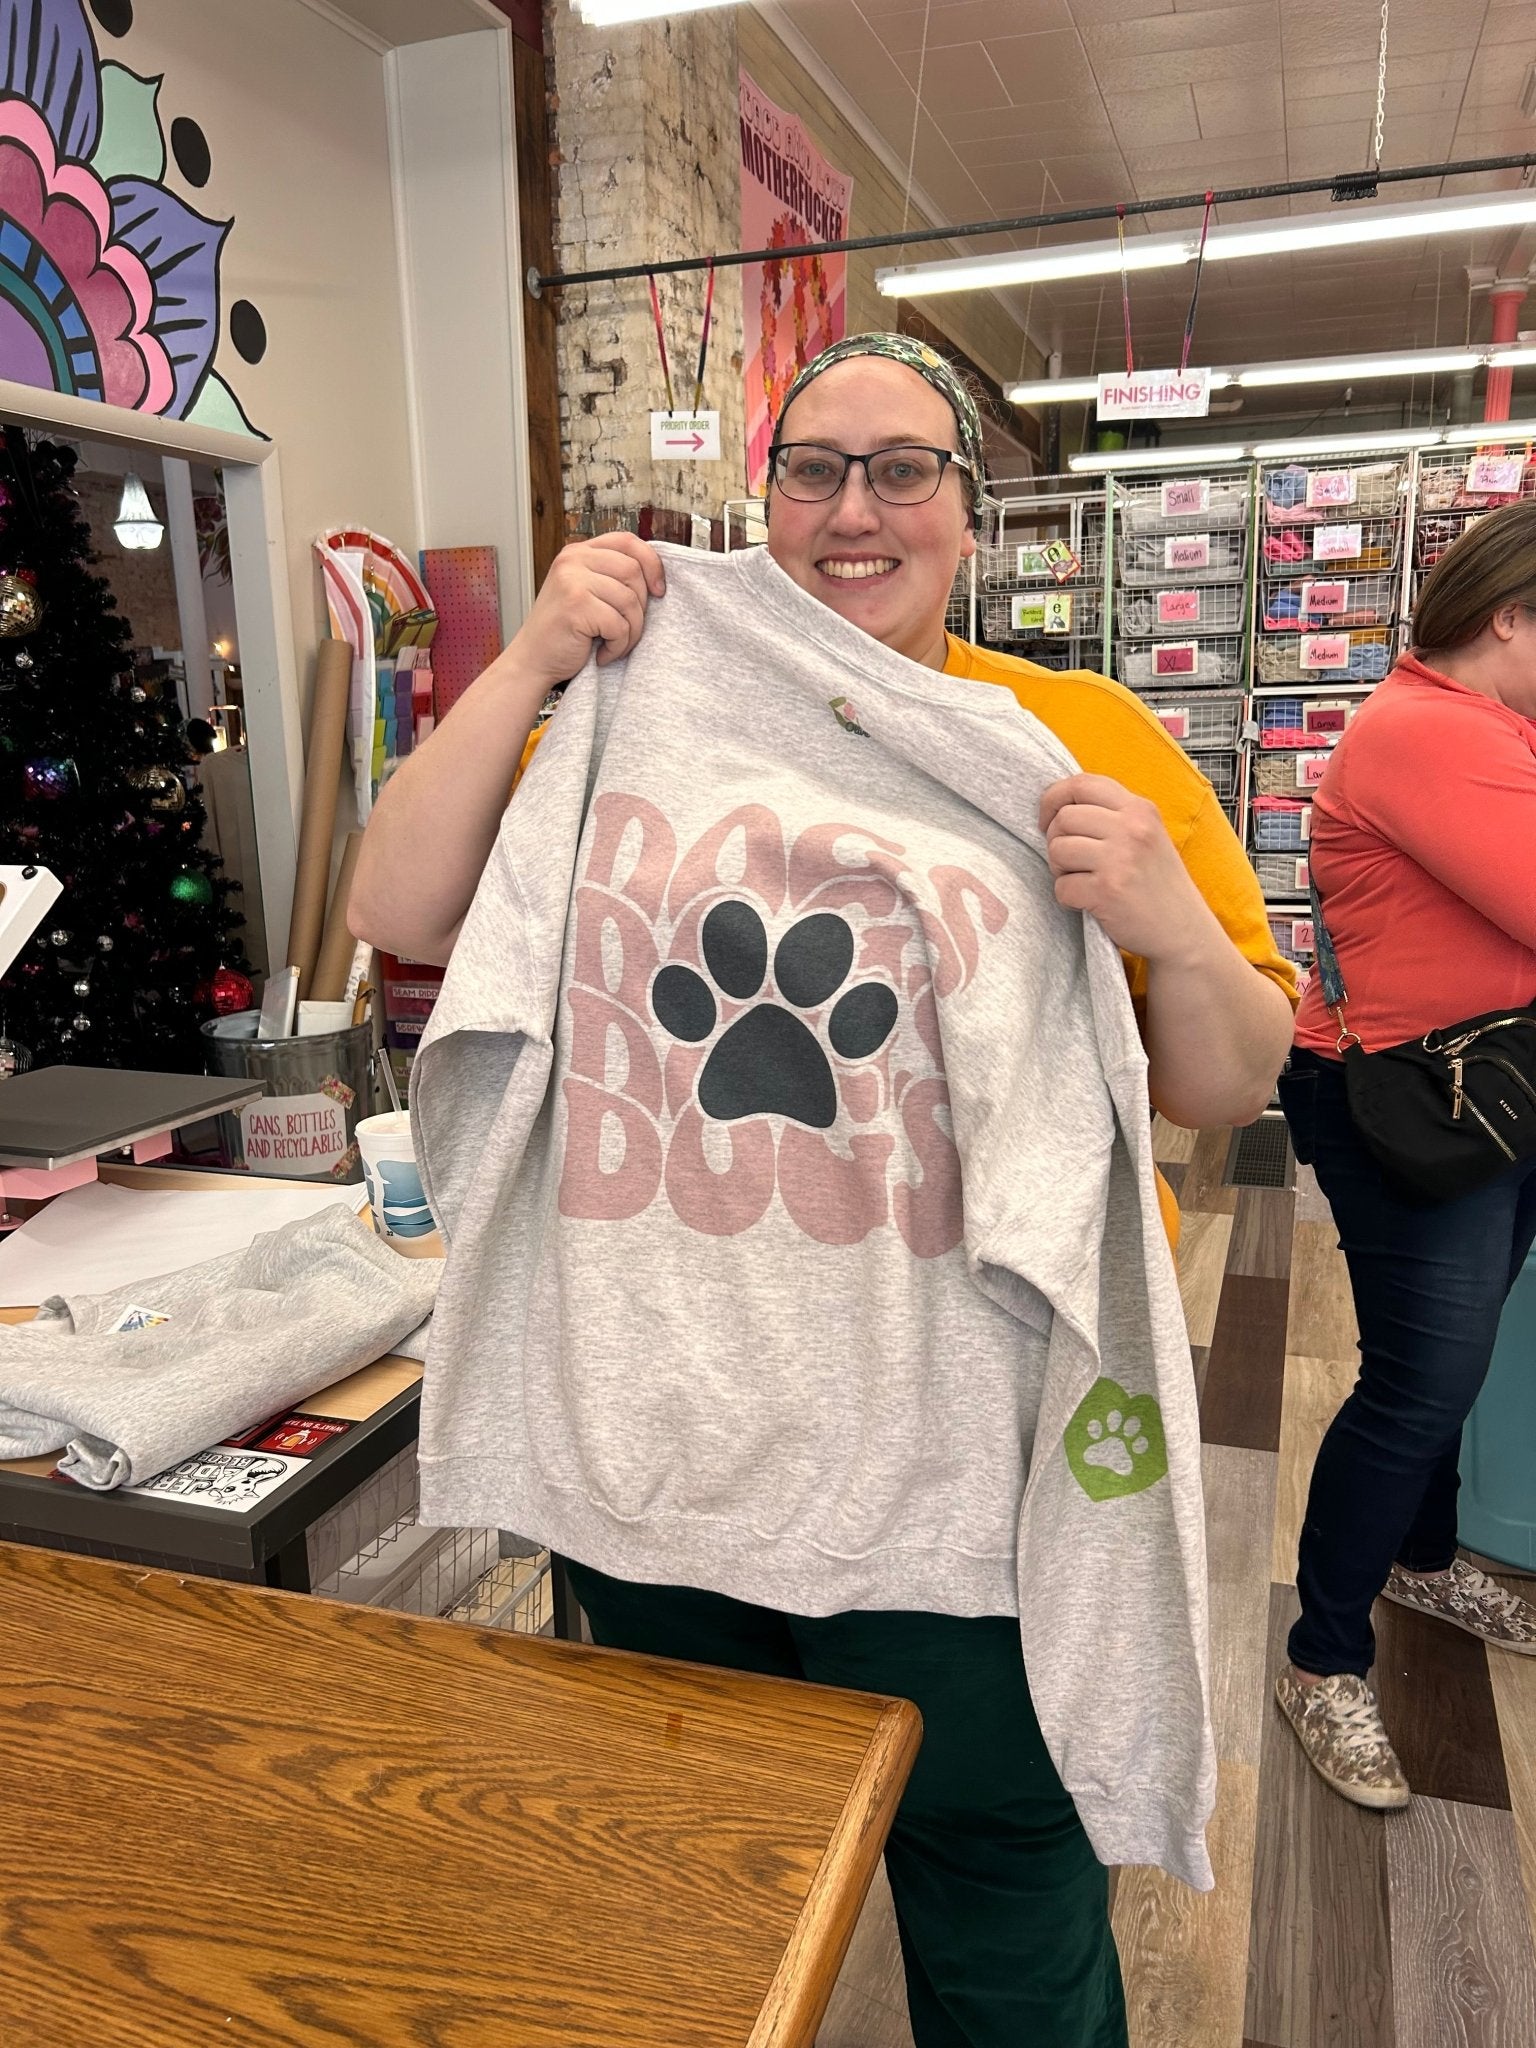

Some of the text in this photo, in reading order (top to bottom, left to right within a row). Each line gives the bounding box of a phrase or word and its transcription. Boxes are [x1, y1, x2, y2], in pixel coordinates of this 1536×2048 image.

[740, 83, 782, 150] EACE
[740, 116, 842, 242] MOTHERFUCKER
[1103, 384, 1201, 405] FINISHING
[661, 421, 710, 430] PRIORITY ORDER
[1168, 488, 1195, 507] Small
[1173, 548, 1203, 563] Medium
[1053, 603, 1062, 614] e
[1309, 594, 1339, 607] Medium
[1309, 648, 1339, 661] Medium
[1311, 715, 1337, 730] Large
[583, 791, 1010, 1000] DOGS
[249, 1108, 336, 1137] CANS, BOTTLES
[247, 1131, 344, 1159] AND RECYCLABLES
[312, 1423, 344, 1432] WHAT'S
